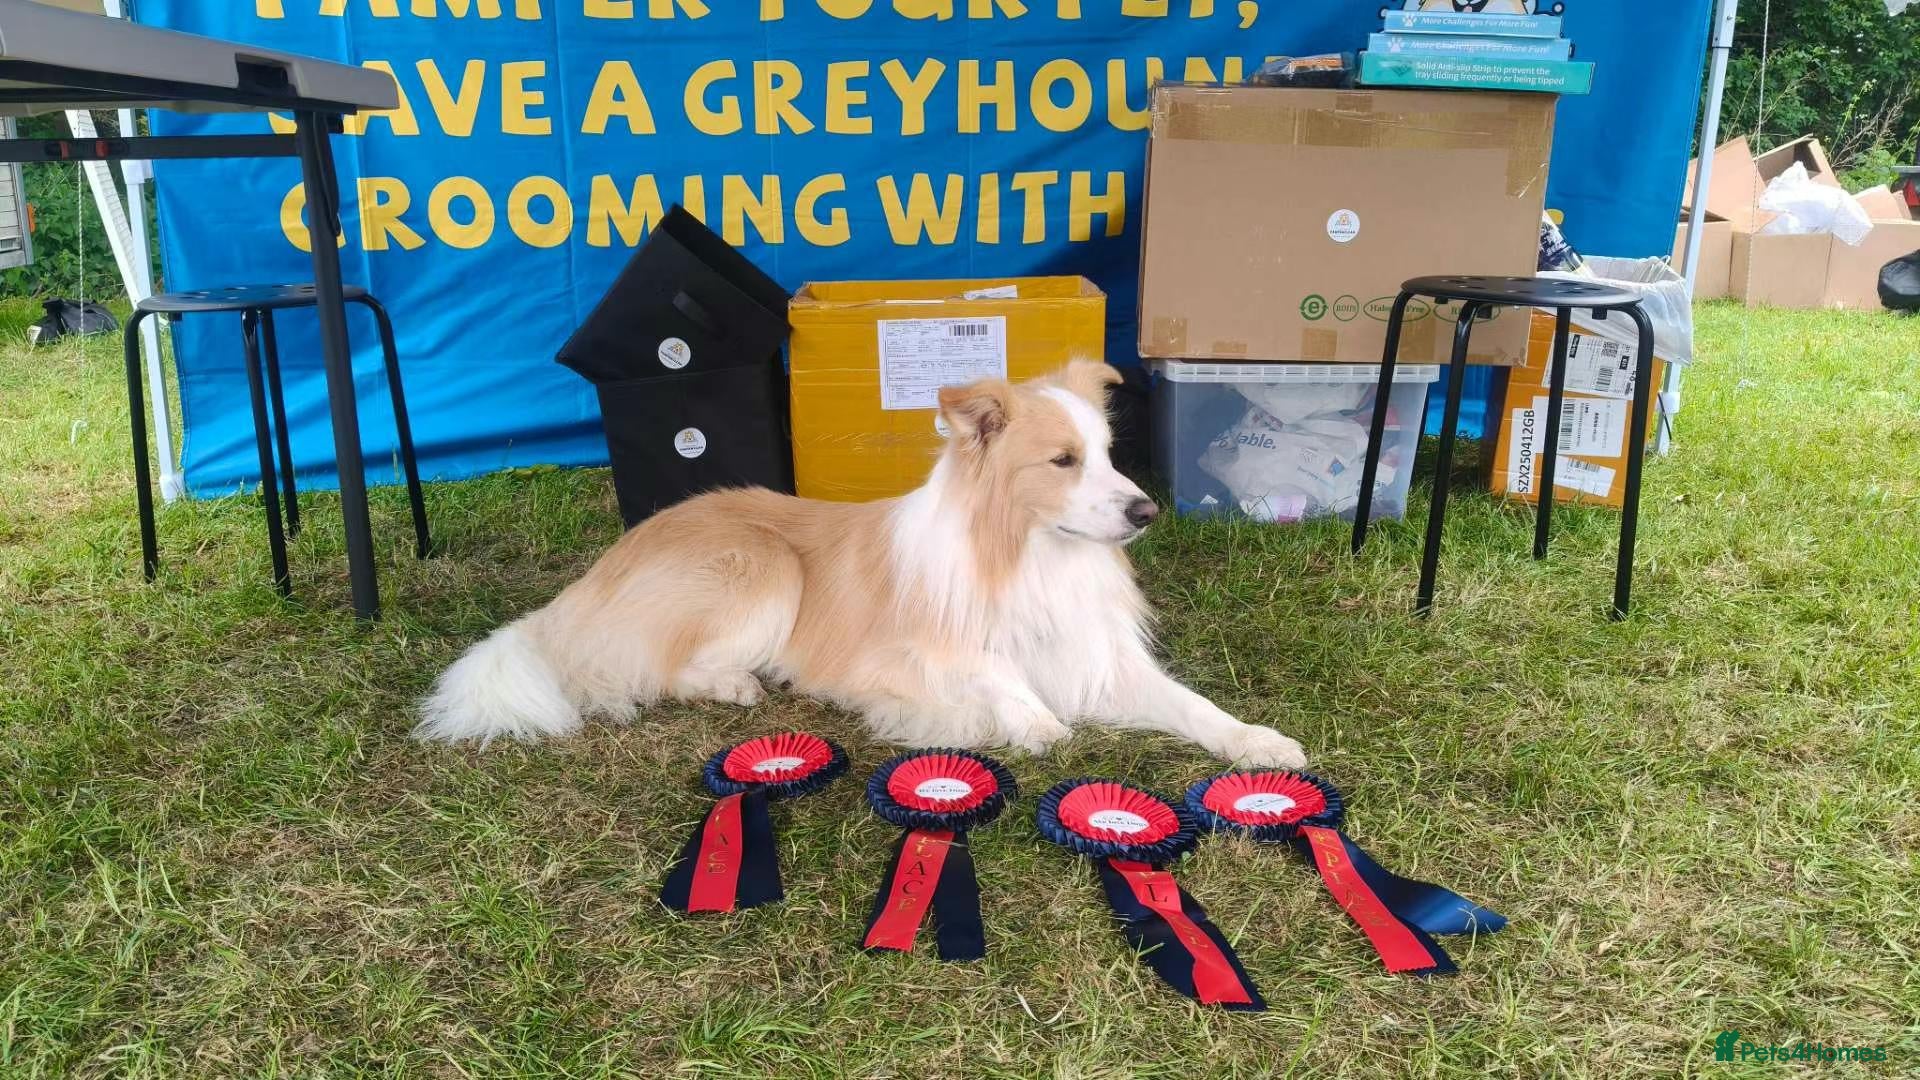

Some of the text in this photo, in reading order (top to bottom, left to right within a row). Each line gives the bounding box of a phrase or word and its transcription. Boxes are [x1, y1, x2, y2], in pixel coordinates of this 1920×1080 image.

[269, 57, 1288, 136] AVE A GREYHOU
[1493, 65, 1502, 73] to
[1503, 67, 1534, 76] prevent
[876, 170, 1126, 246] WITH
[1518, 409, 1535, 494] SZX250412GB
